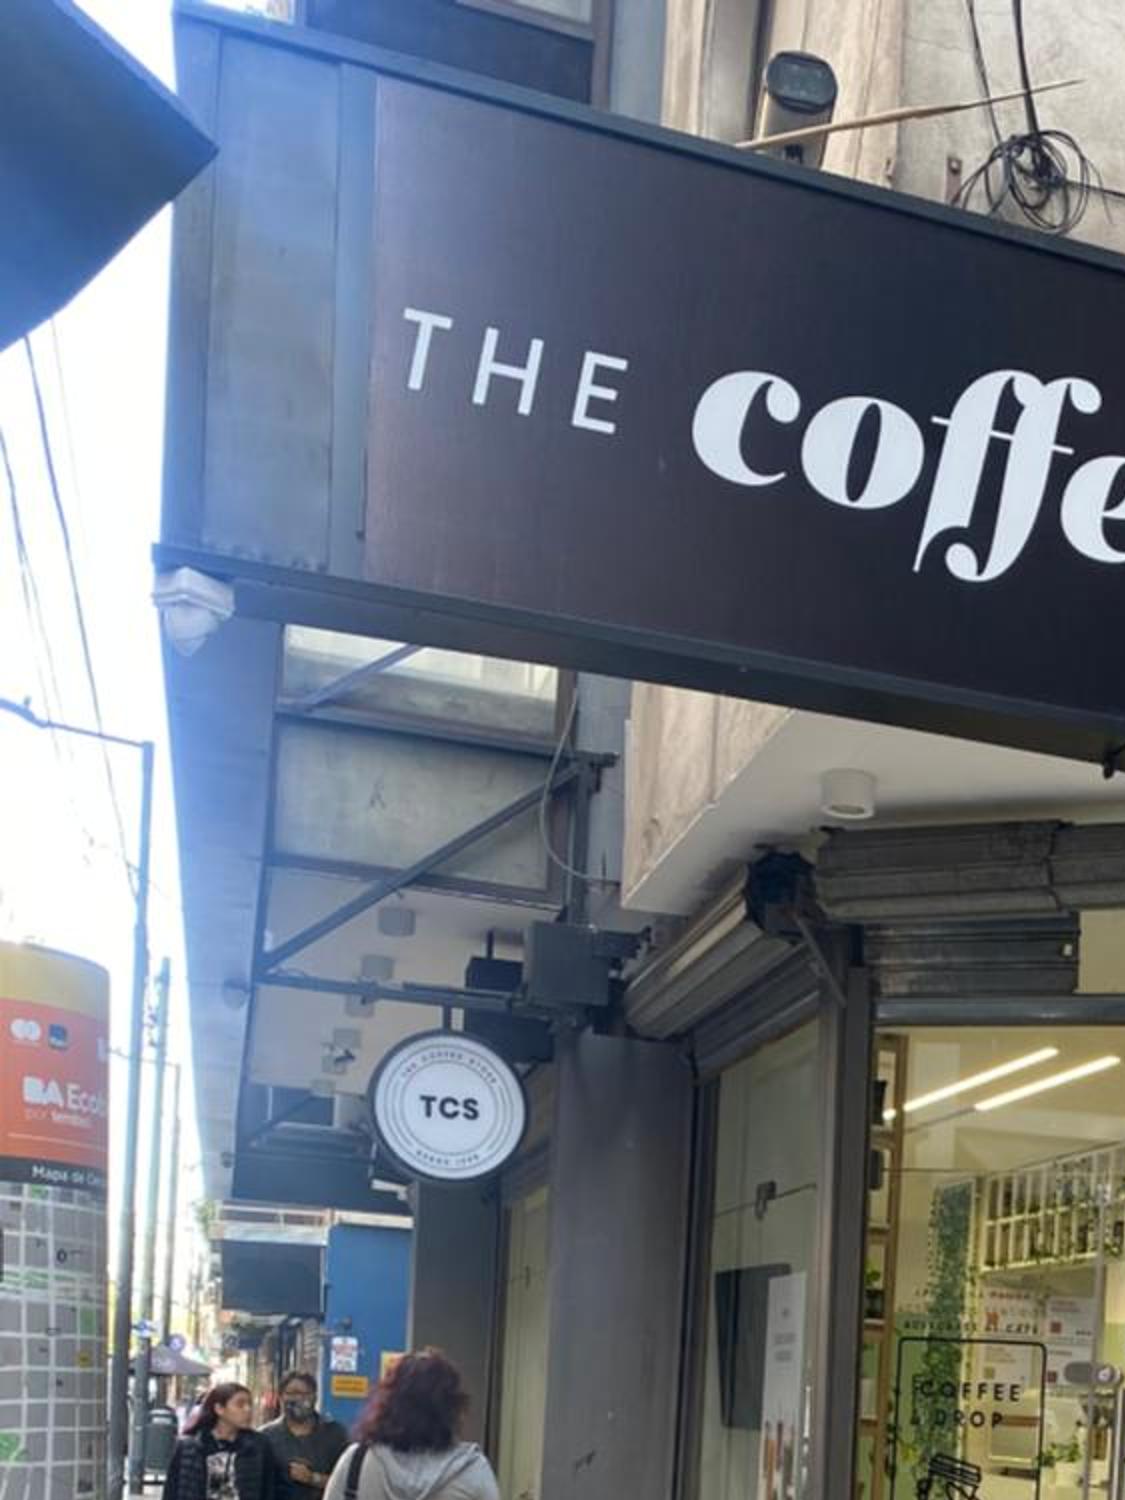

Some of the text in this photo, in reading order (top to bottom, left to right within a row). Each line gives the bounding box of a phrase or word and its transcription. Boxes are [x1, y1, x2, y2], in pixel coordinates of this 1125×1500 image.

[403, 308, 628, 434] THE
[419, 1095, 479, 1121] TCS
[920, 1380, 1022, 1402] COFFEE
